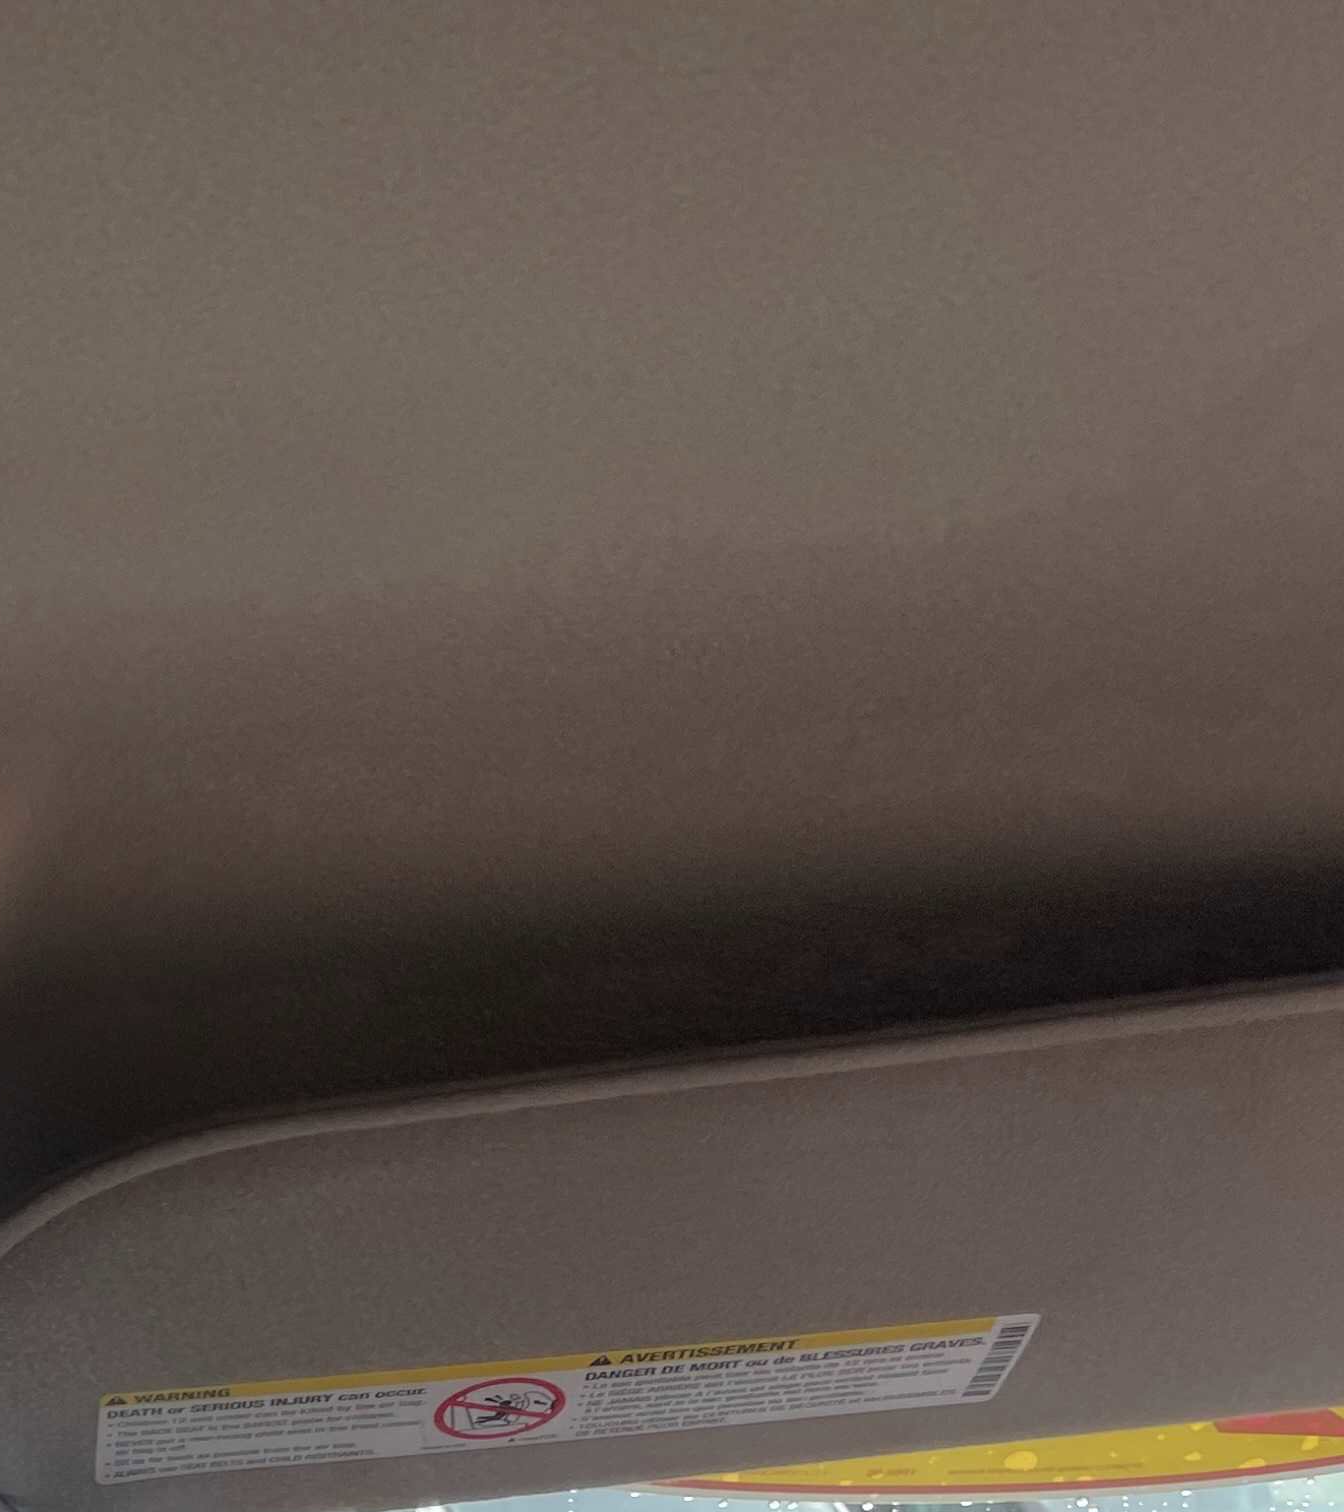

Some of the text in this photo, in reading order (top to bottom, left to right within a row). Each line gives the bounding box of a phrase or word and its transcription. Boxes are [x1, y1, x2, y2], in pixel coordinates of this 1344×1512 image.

[585, 1367, 657, 1381] DANGER
[661, 1364, 685, 1375] DE
[690, 1359, 742, 1372] MORT
[746, 1358, 768, 1368] ou
[773, 1355, 795, 1366] de
[799, 1344, 907, 1362] BLESSURES
[621, 1339, 800, 1364] AVERTISSEMENT
[107, 1407, 164, 1420] DEATH
[168, 1406, 186, 1415] or
[190, 1400, 265, 1414] SERIOUS
[269, 1393, 334, 1407] INJURY
[338, 1391, 370, 1401] can
[134, 1387, 230, 1404] WARNING
